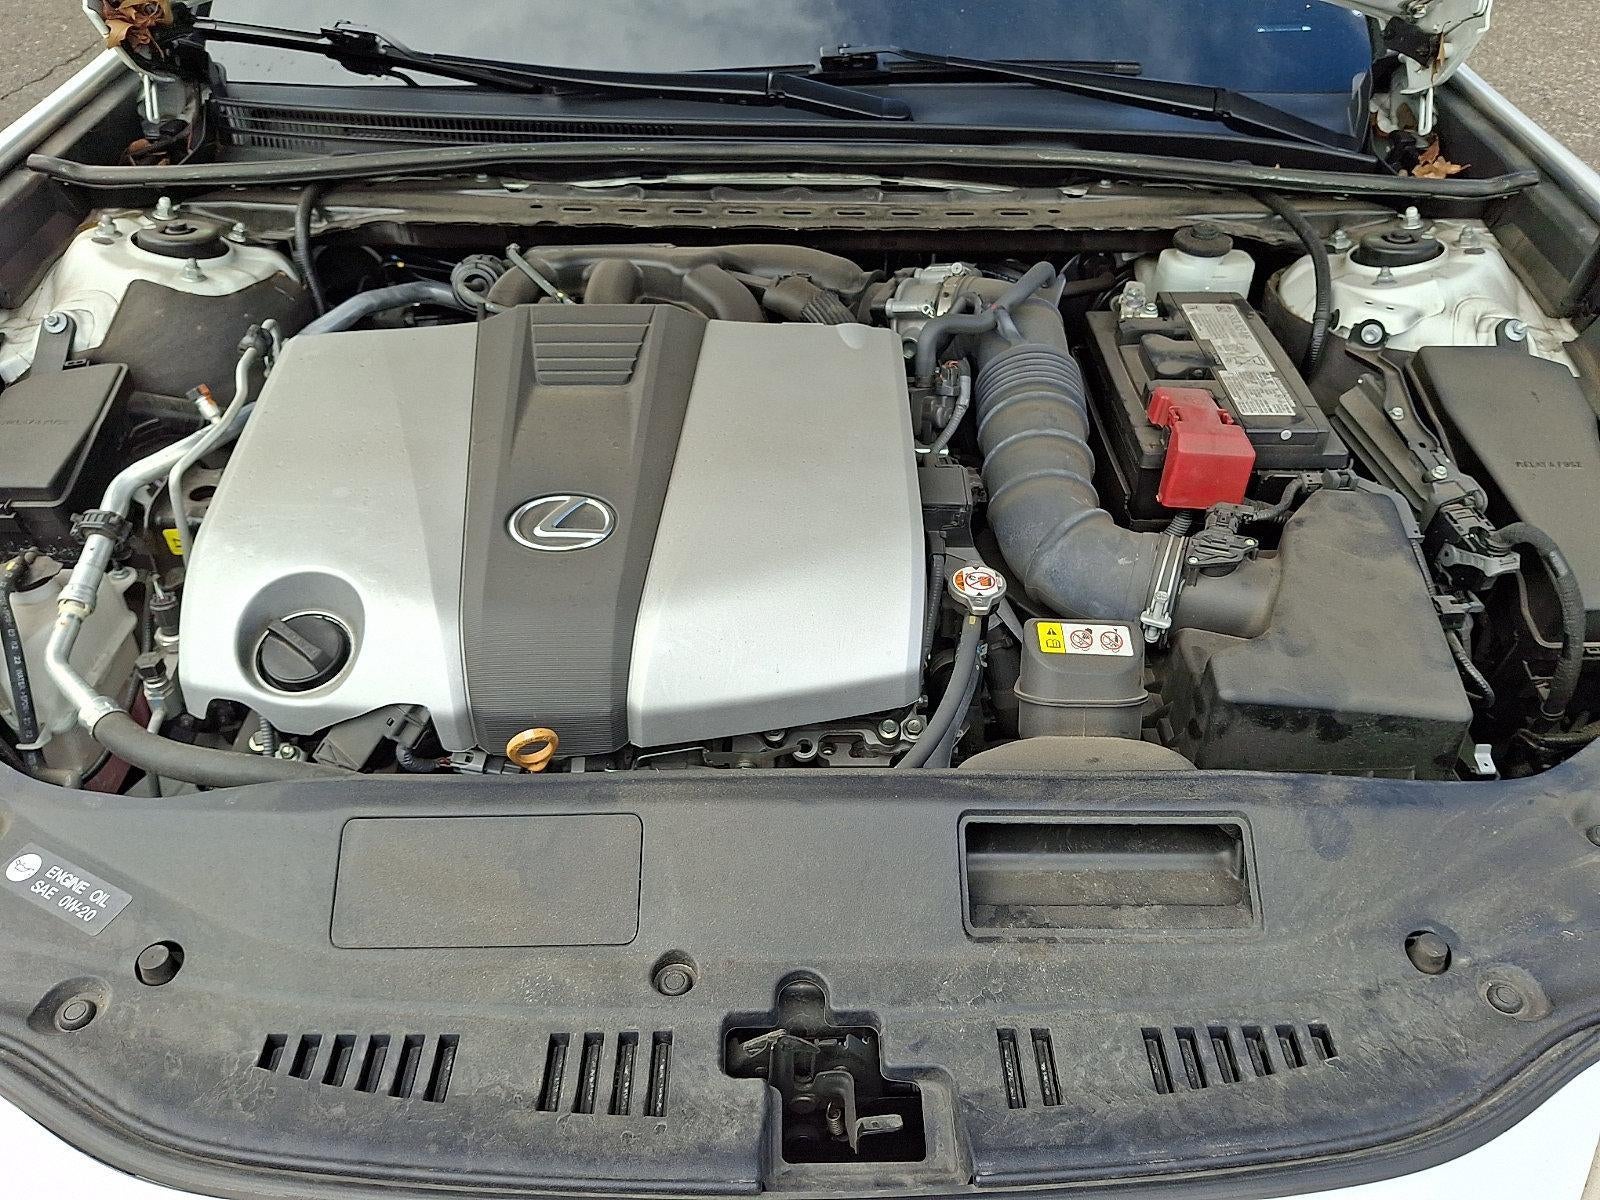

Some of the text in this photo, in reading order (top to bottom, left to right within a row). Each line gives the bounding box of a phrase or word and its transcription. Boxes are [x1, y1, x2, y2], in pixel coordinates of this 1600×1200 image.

[30, 880, 98, 922] SAE 0W-20
[44, 865, 111, 909] ENGINE OIL
